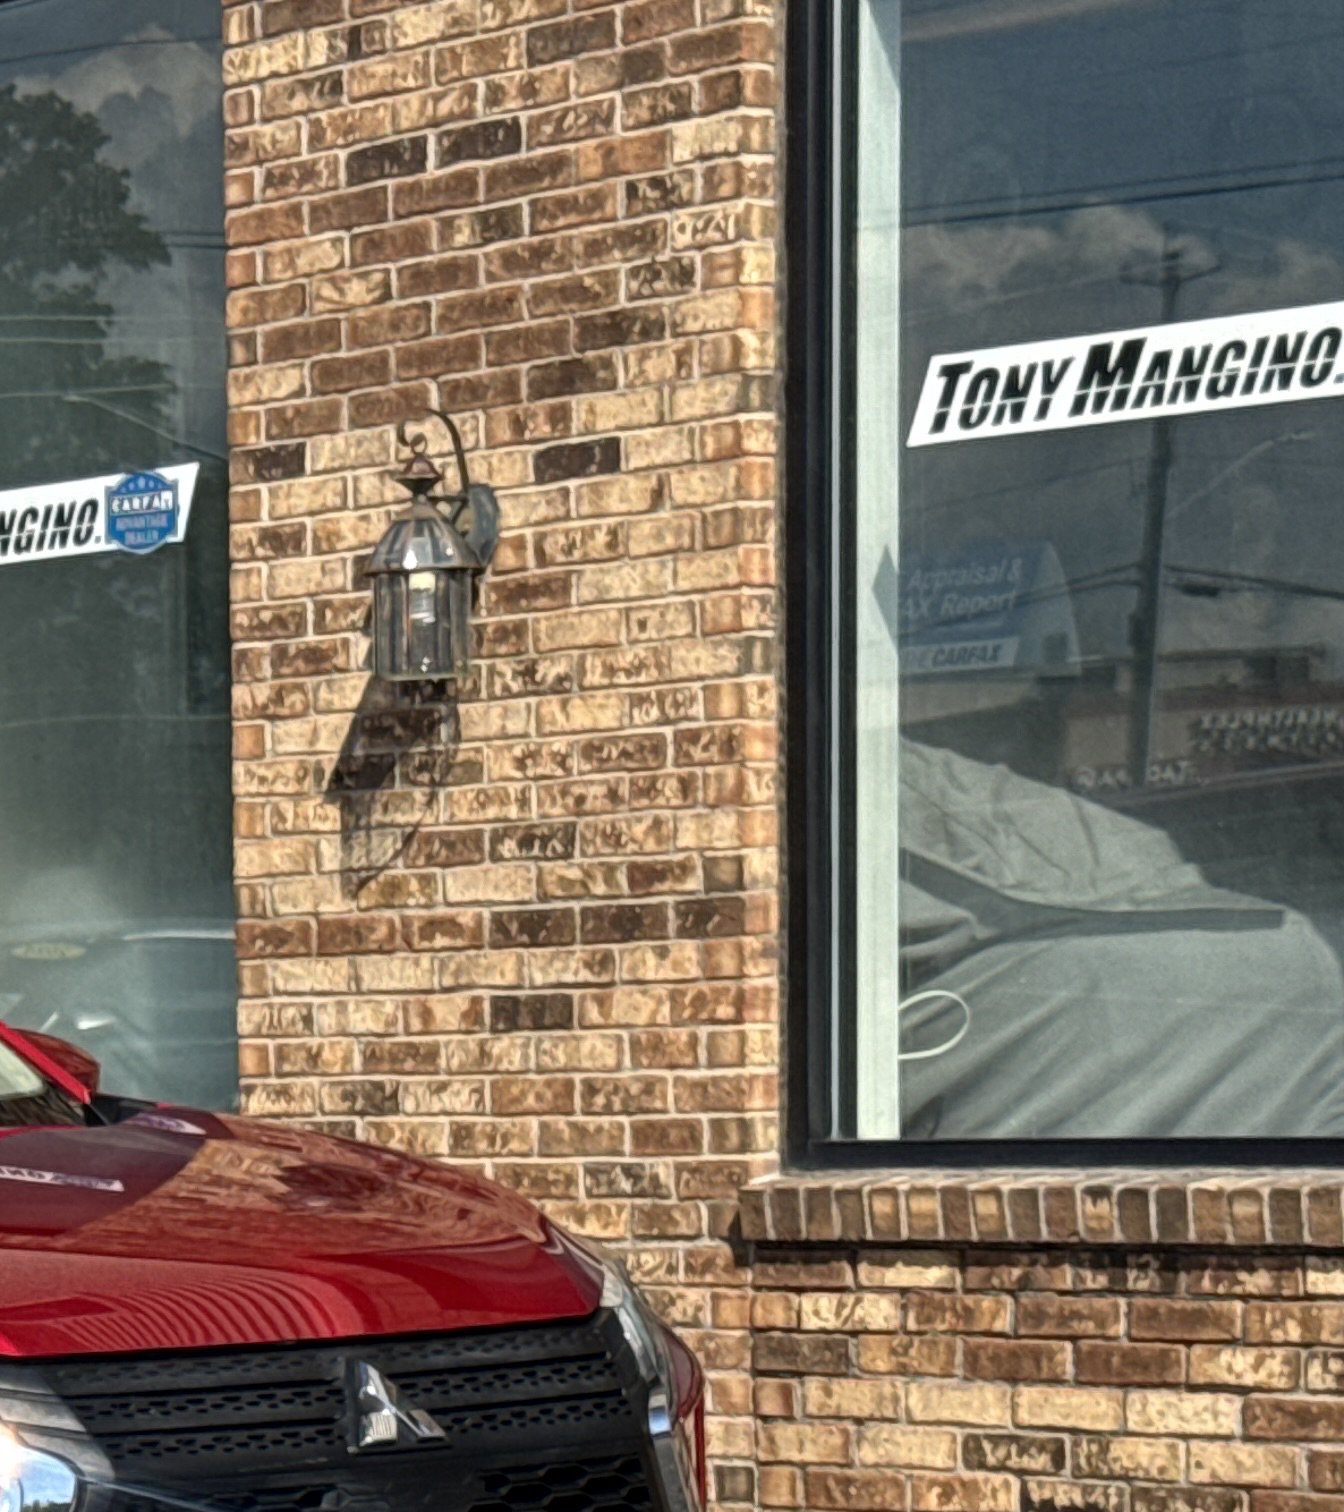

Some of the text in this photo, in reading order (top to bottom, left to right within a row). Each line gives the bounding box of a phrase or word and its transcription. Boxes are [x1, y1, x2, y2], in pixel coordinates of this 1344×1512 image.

[929, 359, 1077, 435] TONY
[906, 559, 1007, 592] Appraisal
[940, 590, 1018, 618] Report
[932, 644, 1001, 668] CARFAX
